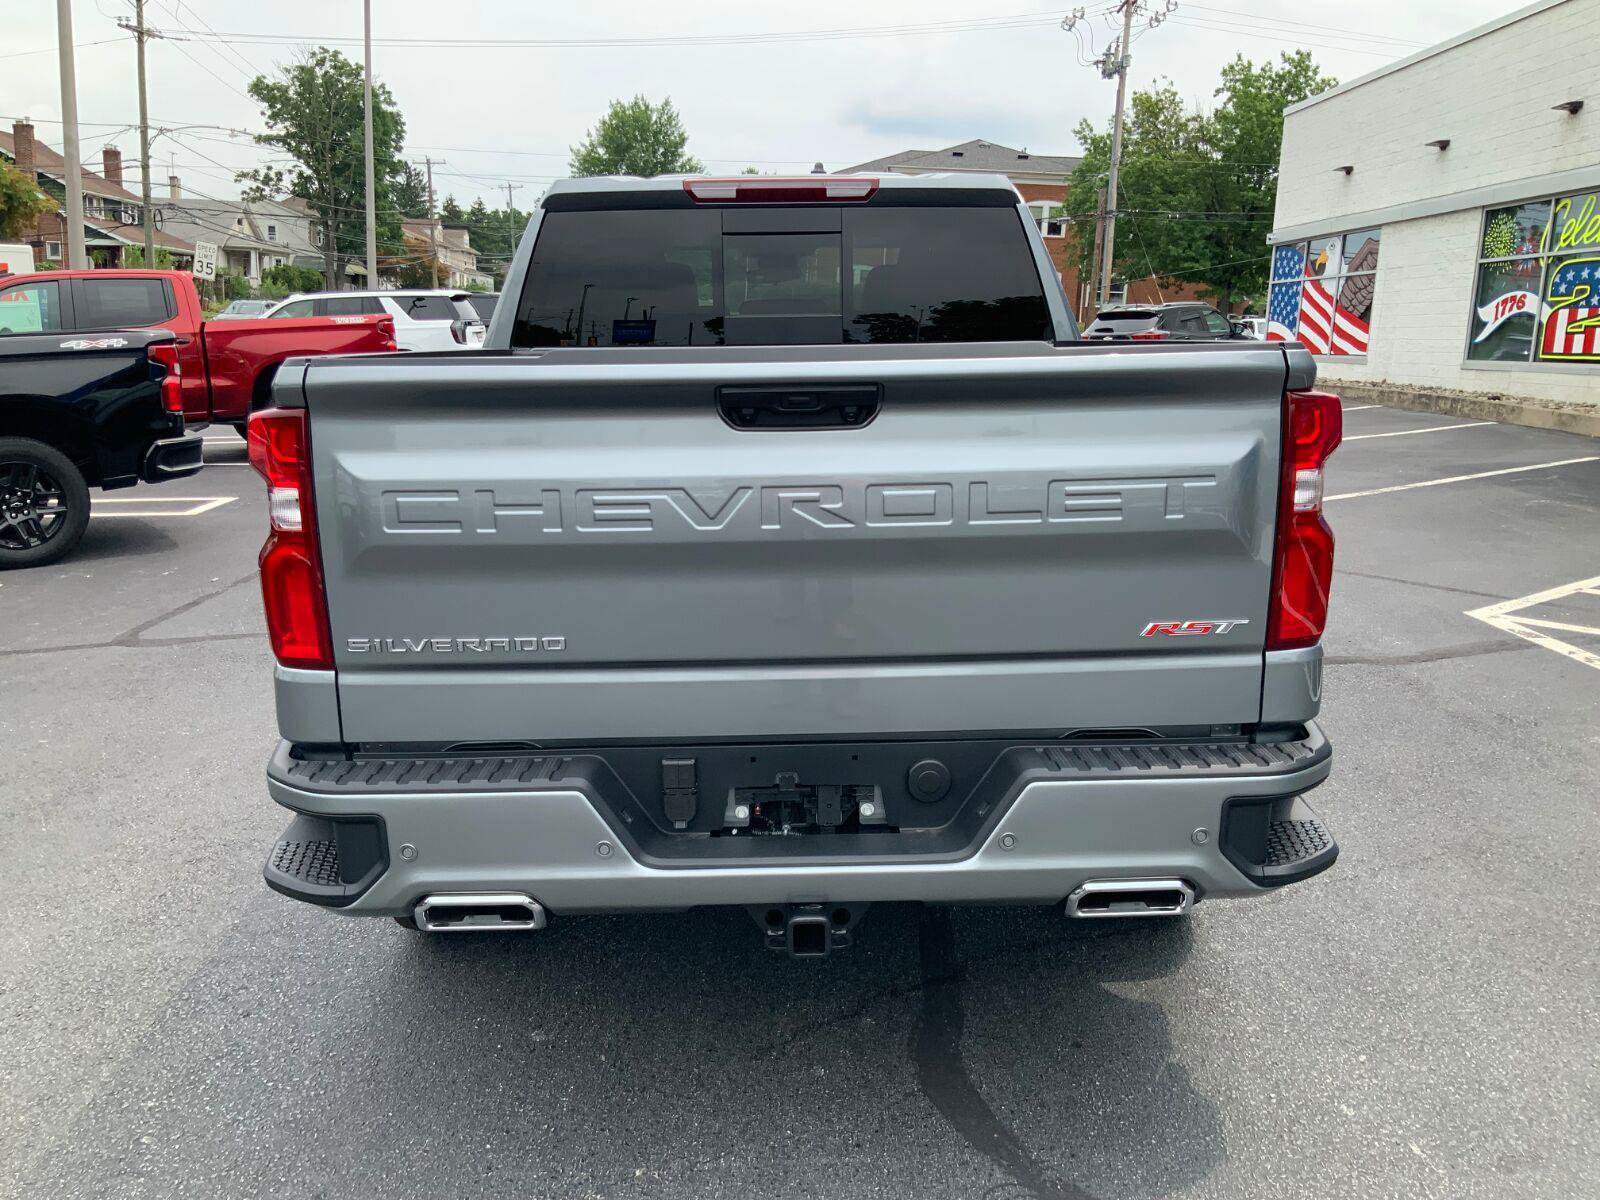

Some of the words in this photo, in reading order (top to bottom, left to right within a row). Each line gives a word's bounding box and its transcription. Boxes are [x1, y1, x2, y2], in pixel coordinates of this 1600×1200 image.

[1540, 194, 1600, 268] Cele
[197, 244, 216, 254] SPEED
[198, 252, 213, 260] LIMIT
[195, 260, 214, 275] 35
[1492, 294, 1527, 324] 1776
[381, 474, 1217, 534] CHEVROLET
[1139, 619, 1250, 637] RST
[347, 637, 567, 653] SILVERADO
